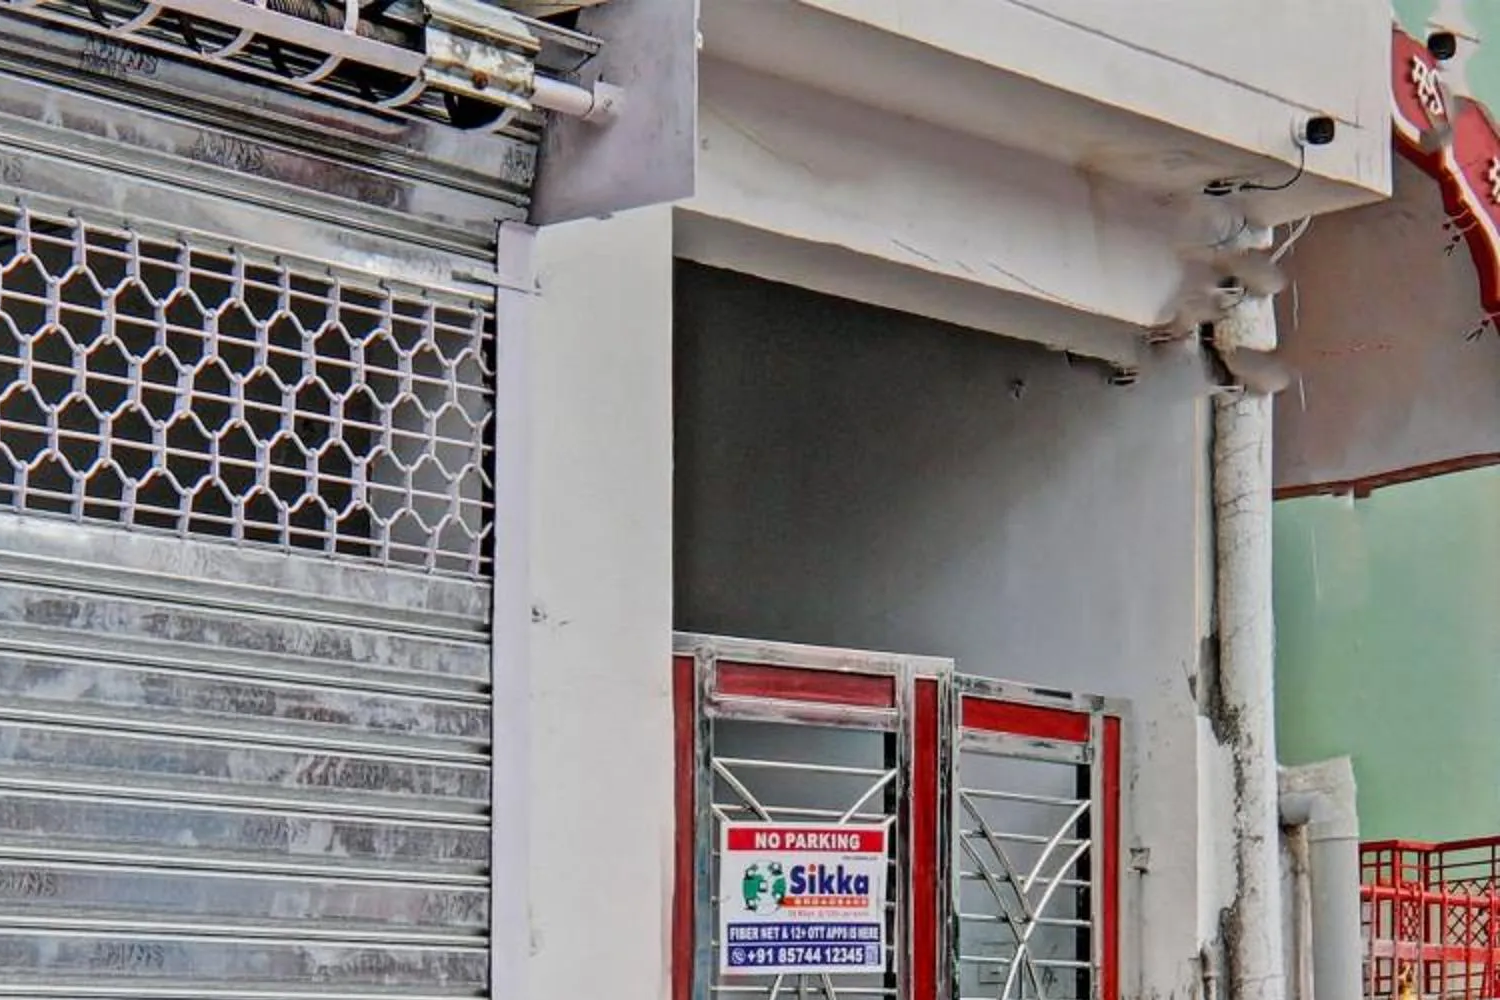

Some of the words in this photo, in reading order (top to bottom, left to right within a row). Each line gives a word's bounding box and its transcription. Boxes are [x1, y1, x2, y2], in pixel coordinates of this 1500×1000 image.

[755, 832, 780, 848] NO
[785, 832, 861, 850] PARKING
[790, 863, 869, 895] Sikka
[748, 948, 774, 963] +91
[824, 947, 863, 963] 12345
